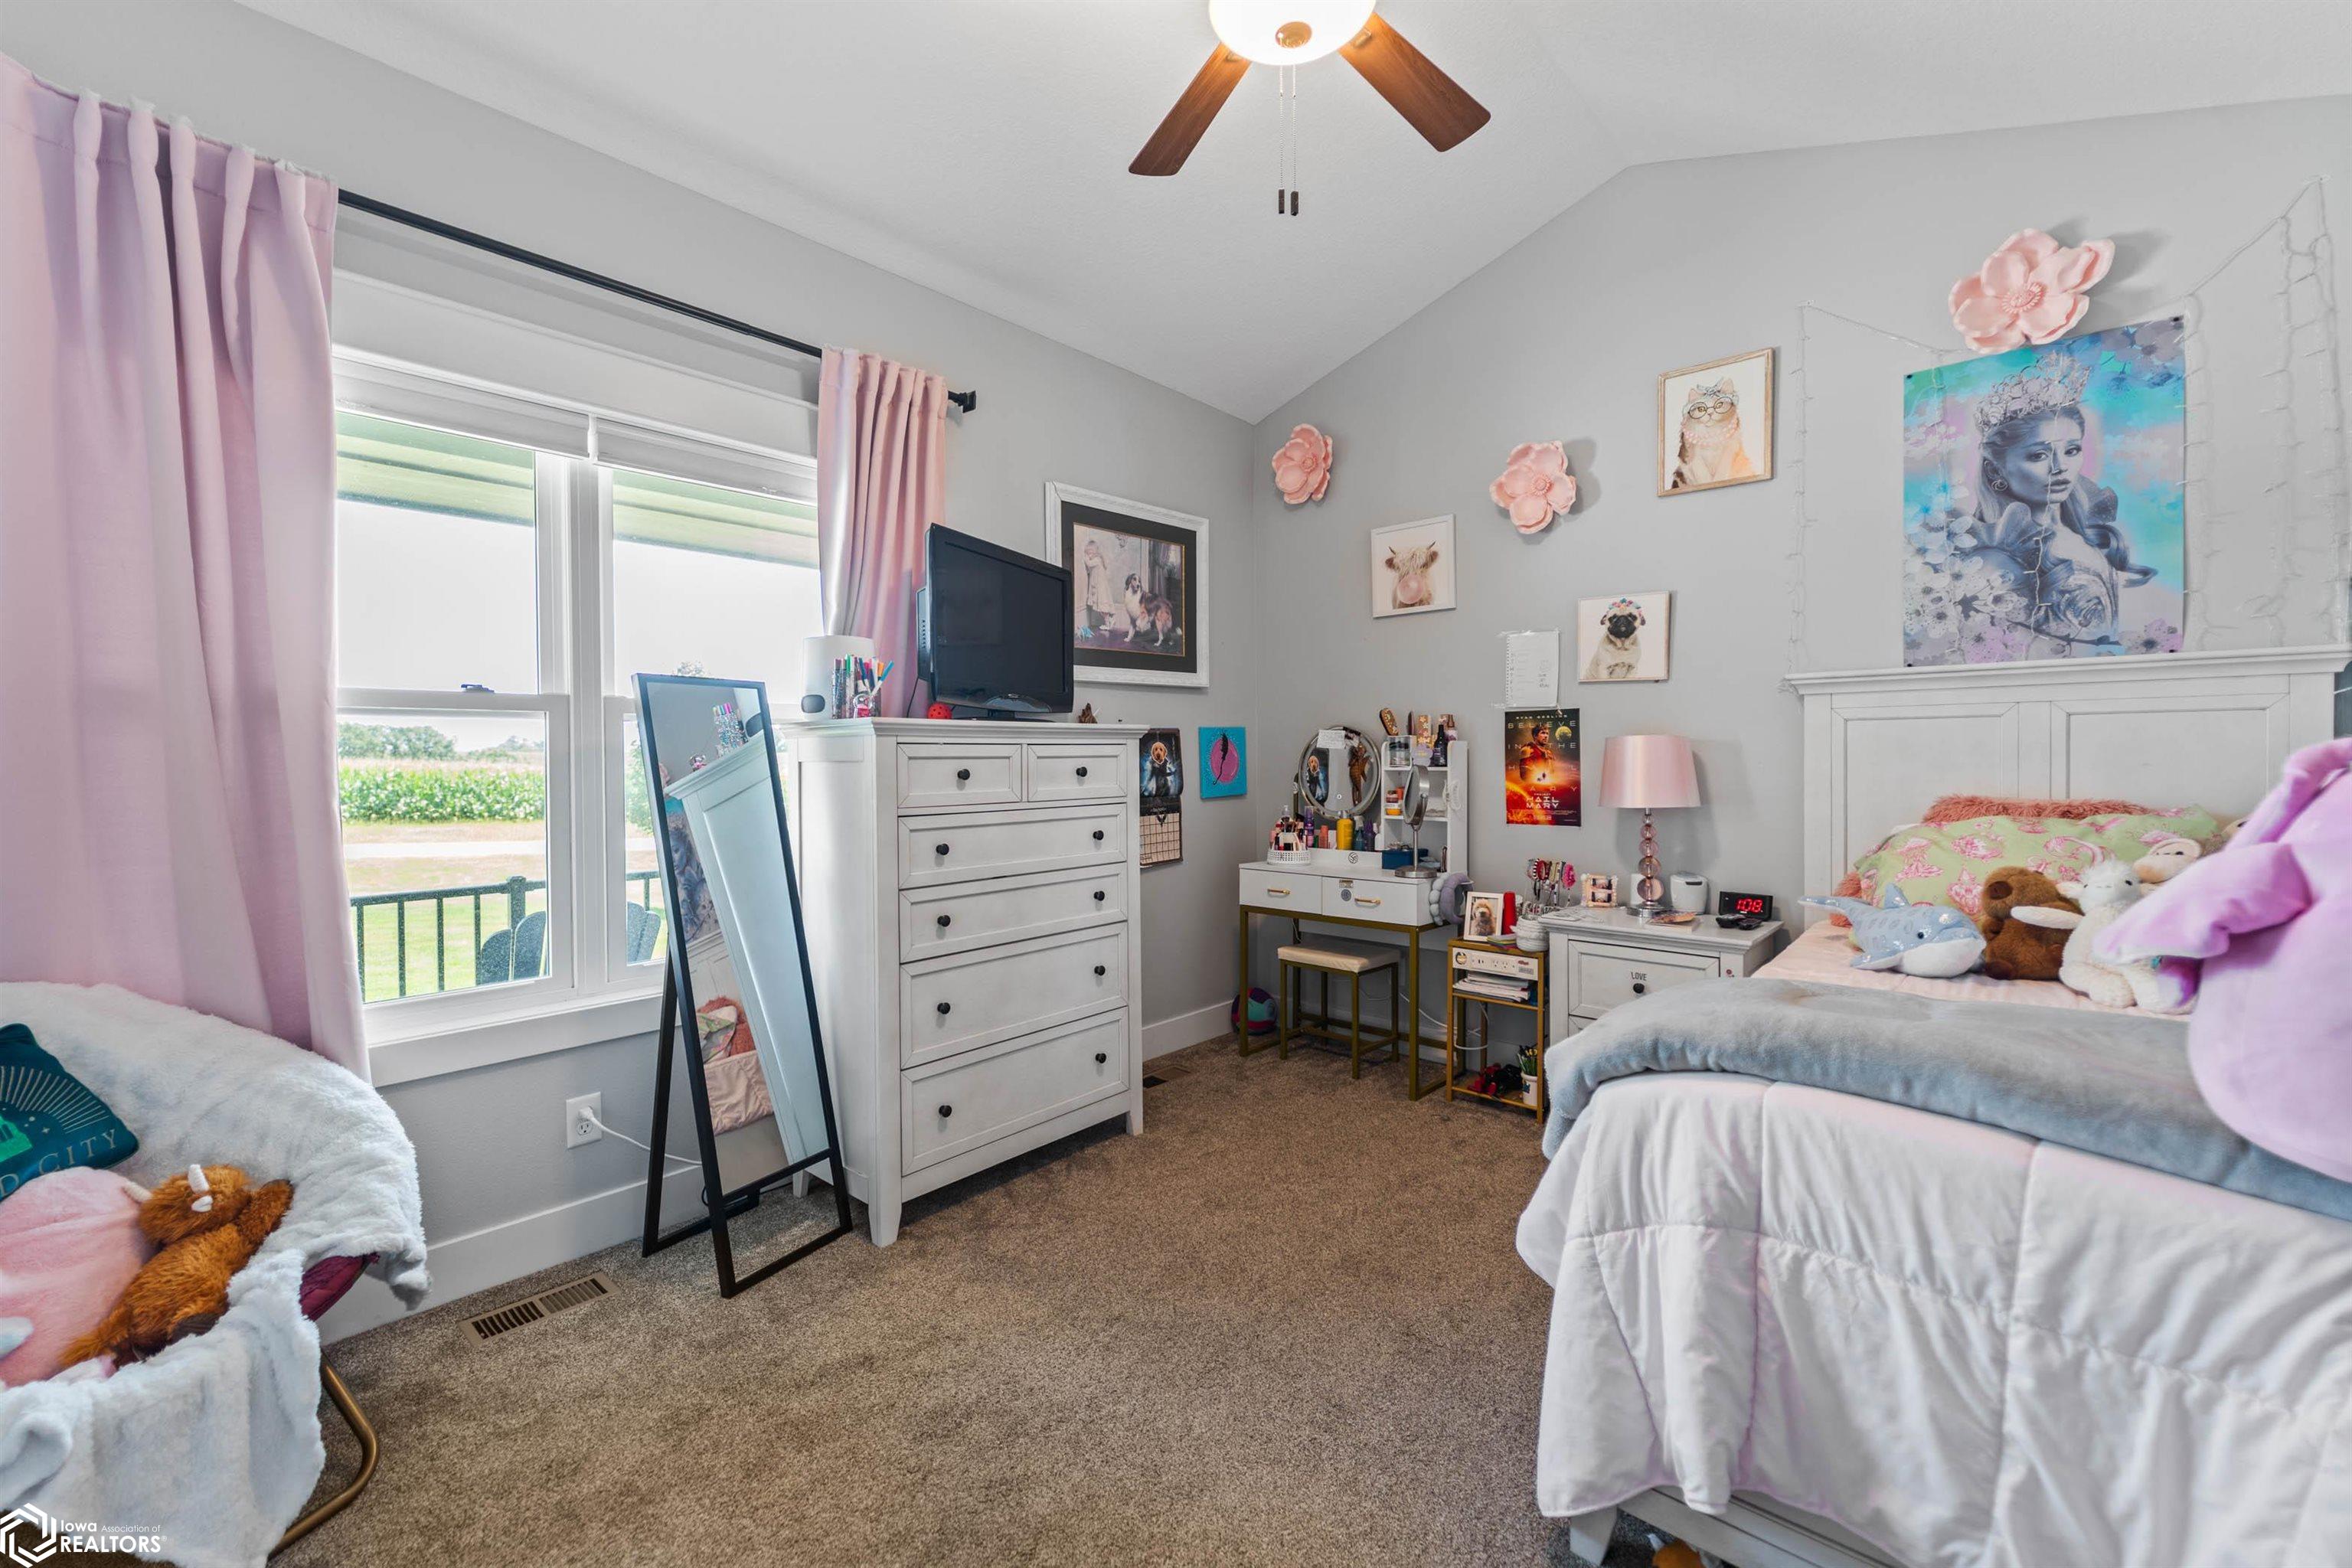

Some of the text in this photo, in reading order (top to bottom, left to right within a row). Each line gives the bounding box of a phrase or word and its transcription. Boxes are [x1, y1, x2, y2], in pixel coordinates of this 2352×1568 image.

[1508, 720, 1576, 729] BELIEVE
[1630, 972, 1648, 981] LOVE
[38, 1129, 116, 1175] CITY
